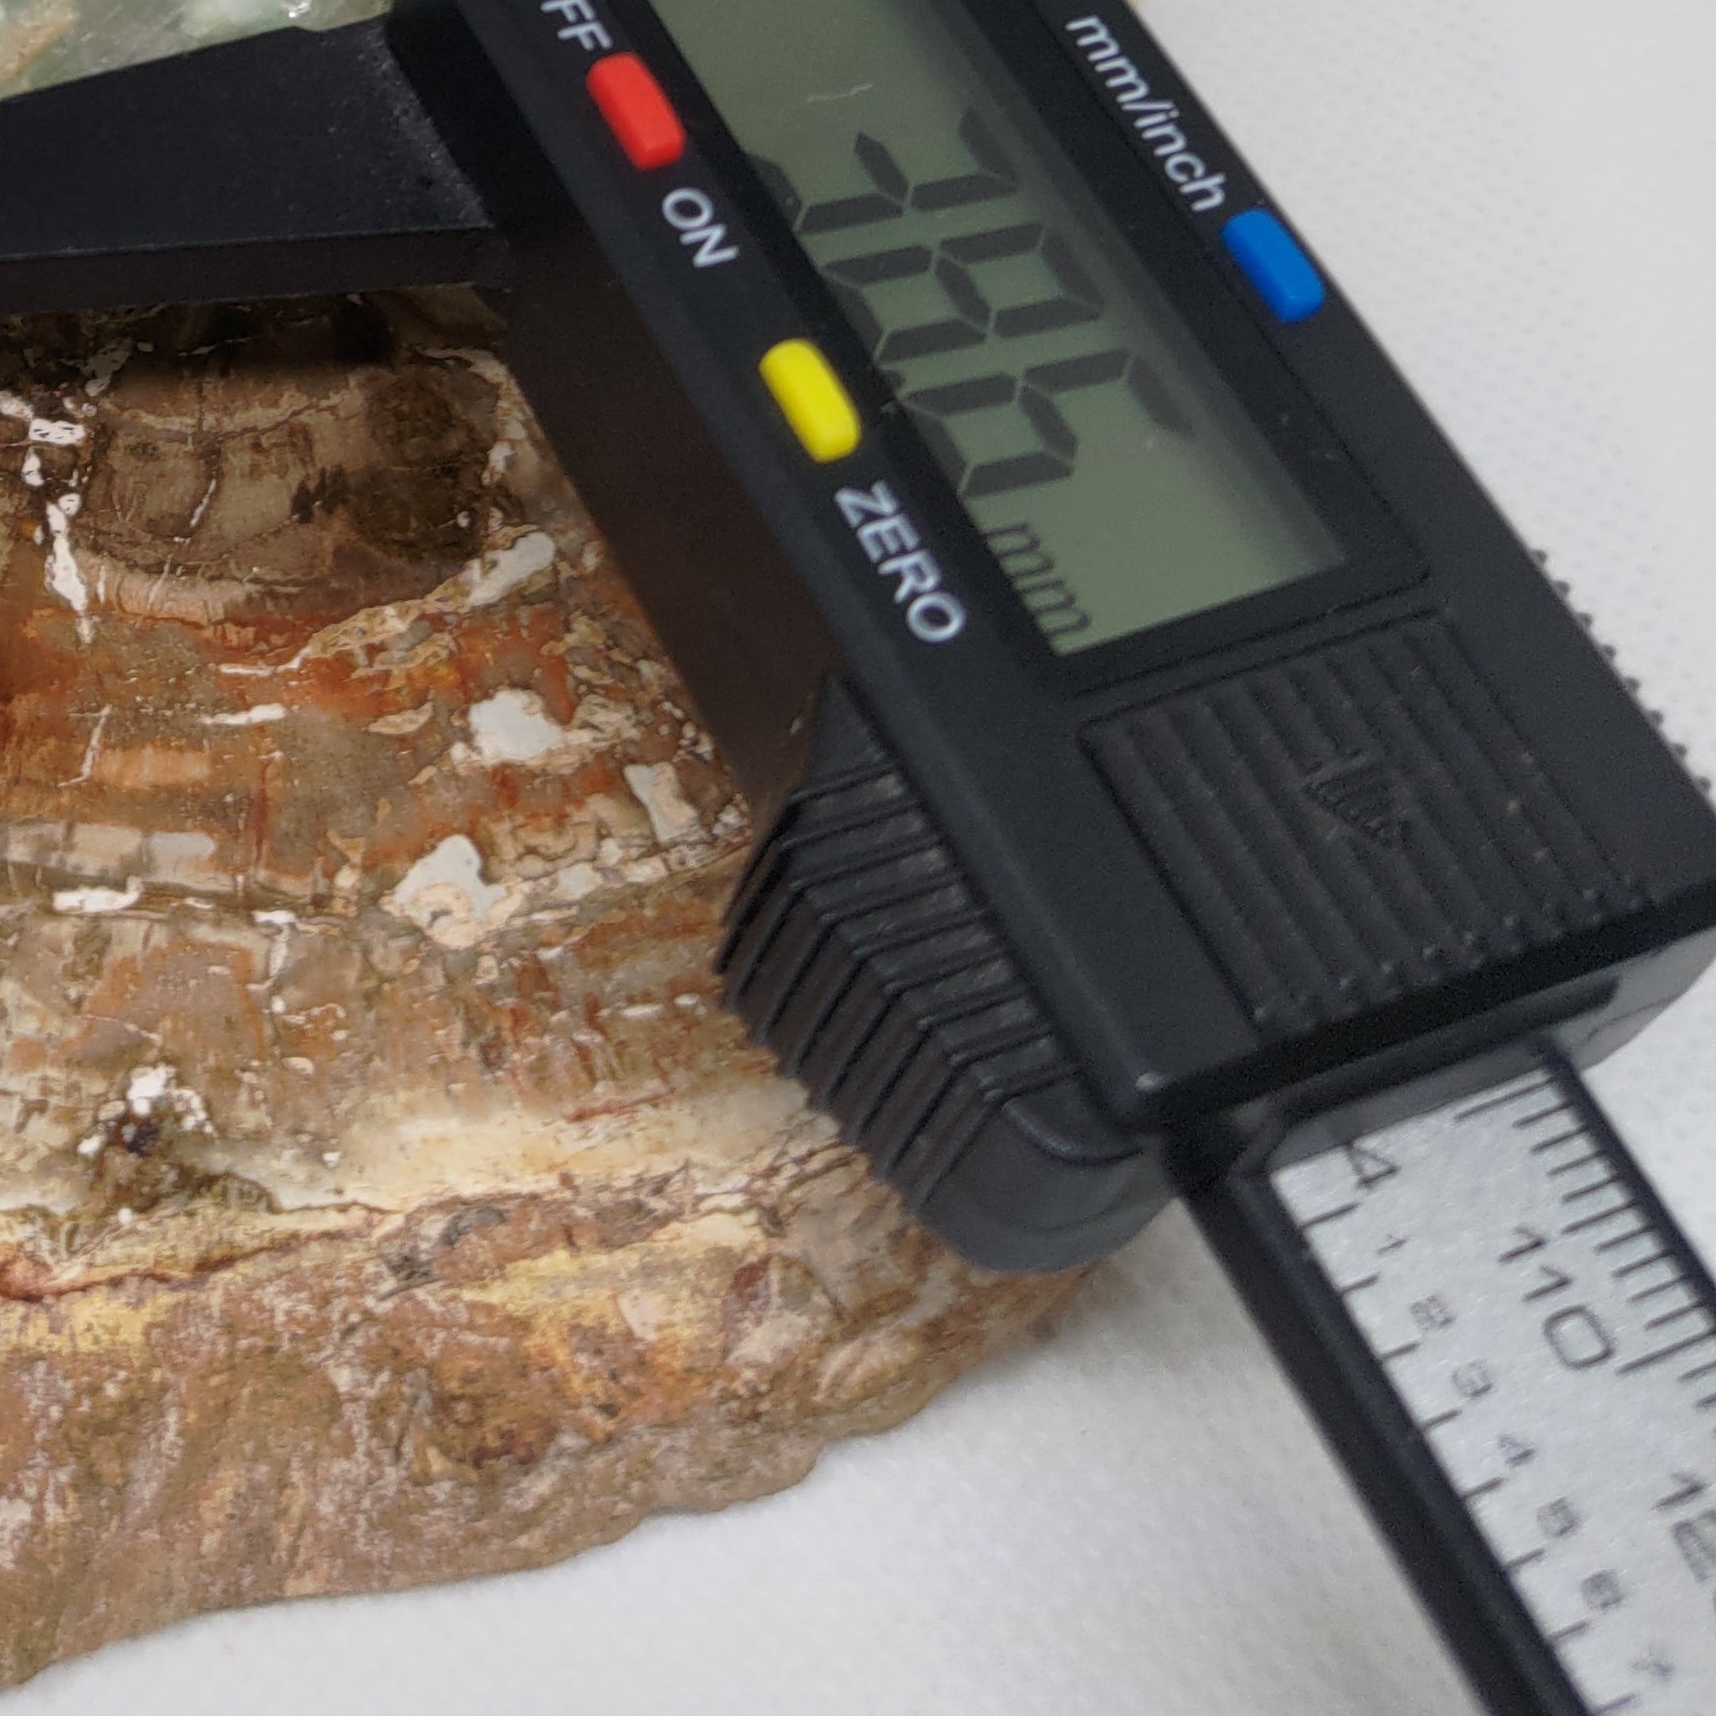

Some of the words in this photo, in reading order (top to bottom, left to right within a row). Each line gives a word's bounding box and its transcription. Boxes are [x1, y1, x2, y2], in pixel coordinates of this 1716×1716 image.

[1065, 15, 1227, 214] mm/inch
[661, 187, 739, 270] ON
[833, 480, 967, 644] ZERO
[984, 523, 1092, 638] mm
[1345, 1142, 1400, 1189] 4
[1497, 1224, 1616, 1372] 110
[1650, 1470, 1716, 1612] 12
